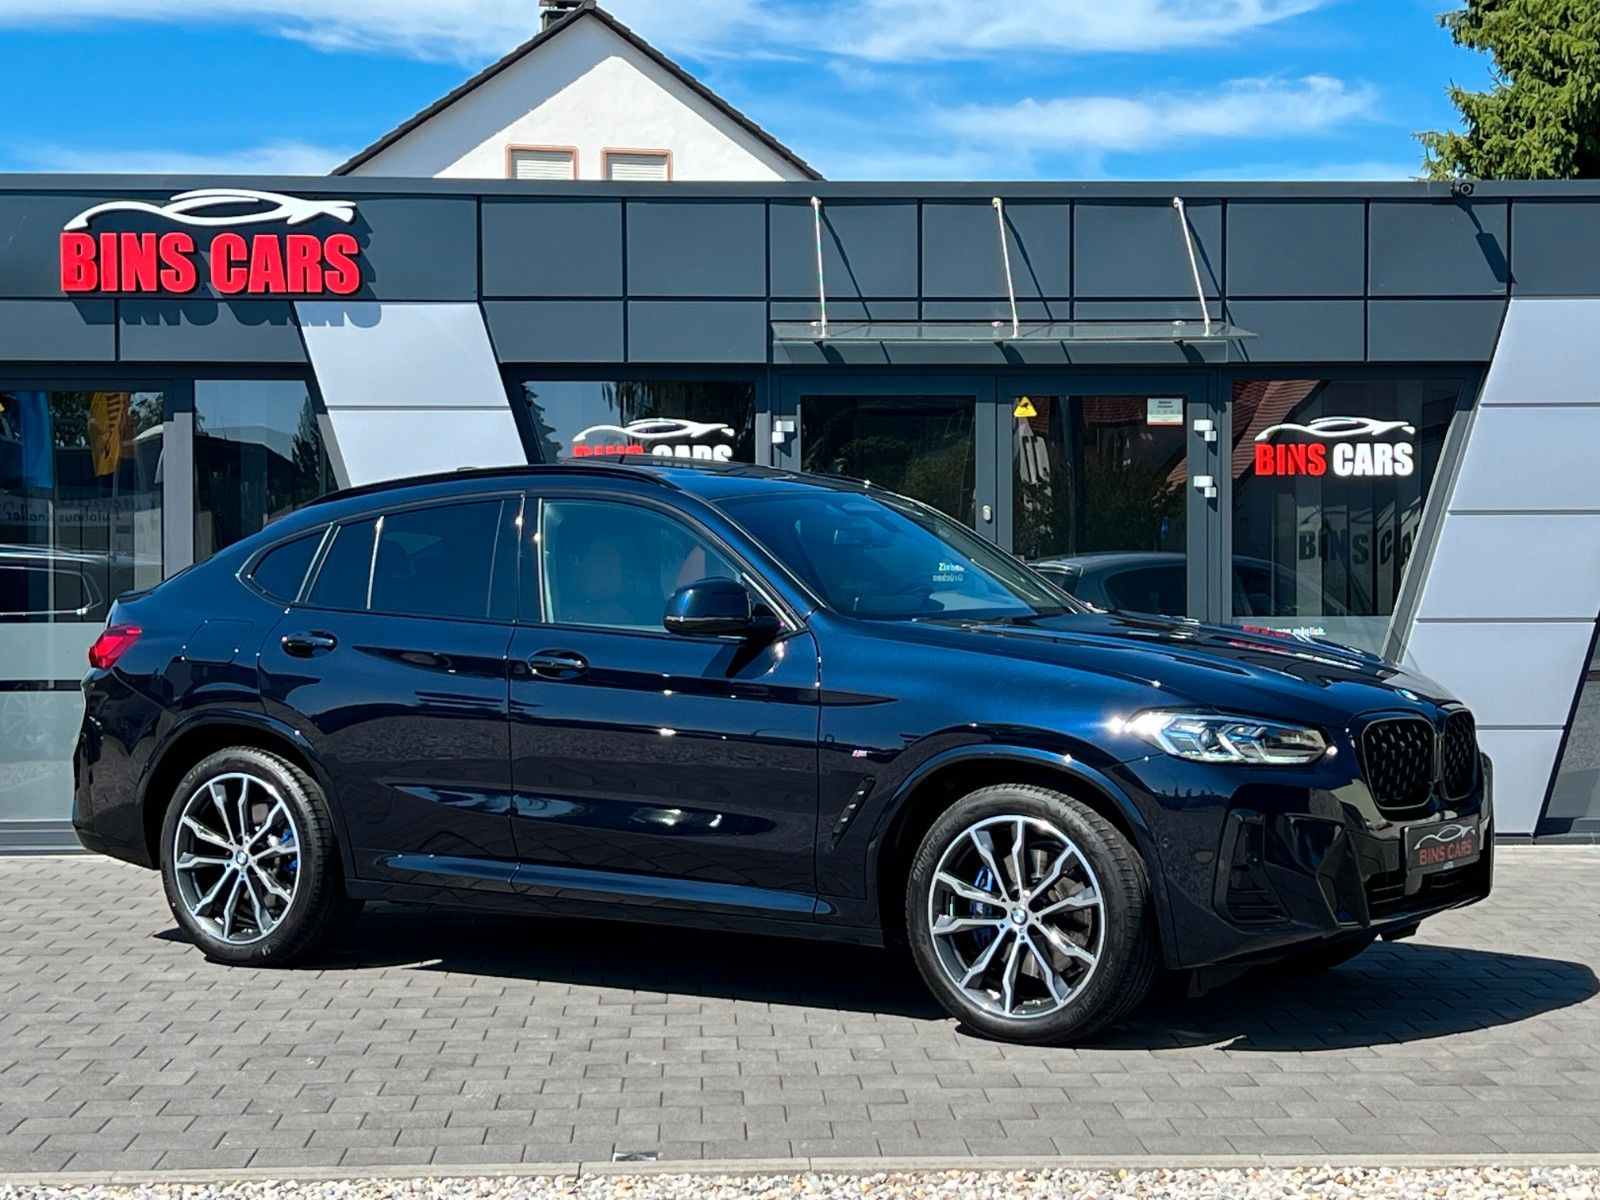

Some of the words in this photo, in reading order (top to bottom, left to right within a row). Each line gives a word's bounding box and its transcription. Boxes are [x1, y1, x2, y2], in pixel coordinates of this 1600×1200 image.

[60, 232, 196, 293] BINS
[210, 232, 360, 294] CARS
[1255, 443, 1327, 477] BINS
[1333, 442, 1415, 477] CARS
[1298, 528, 1369, 565] BINS
[1419, 845, 1446, 866] BINS
[1447, 839, 1473, 860] CARS
